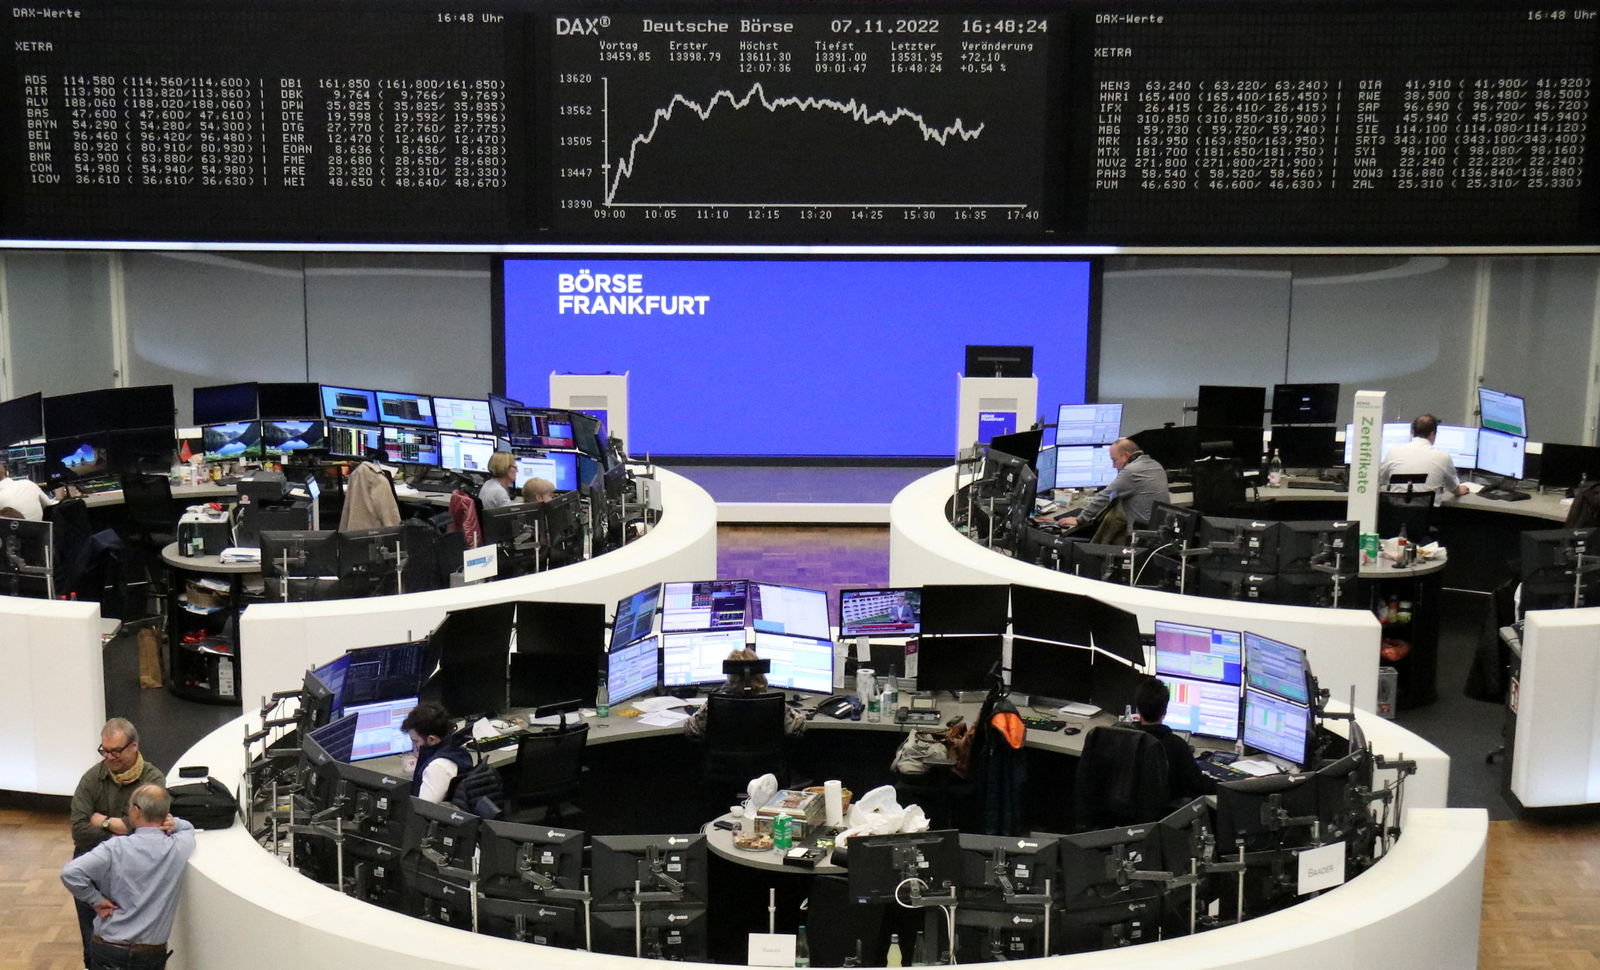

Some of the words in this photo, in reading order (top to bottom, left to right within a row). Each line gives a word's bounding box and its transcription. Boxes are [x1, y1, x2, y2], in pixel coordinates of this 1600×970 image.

[13, 8, 81, 18] DAX-Werte
[1528, 10, 1566, 20] 16:48
[1574, 10, 1597, 20] Uhr
[438, 13, 474, 22] 16:48
[482, 14, 504, 23] Uhr
[1096, 14, 1164, 24] DAX-Werte
[643, 19, 729, 32] Deutsche
[740, 19, 794, 32] Börse
[831, 20, 939, 34] 07.11.2022
[962, 20, 1048, 34] 16:48:24
[15, 42, 53, 51] XETRA
[600, 41, 638, 53] Vortag
[670, 41, 708, 50] Erster
[740, 41, 778, 50] Höchst
[815, 41, 854, 50] Tiefst
[891, 41, 936, 50] Letzter
[962, 42, 1033, 52] Veränderung
[600, 52, 651, 61] 13459.85
[670, 52, 721, 62] 13398.79
[740, 52, 791, 62] 13611.30
[816, 52, 867, 62] 13391.00
[891, 52, 943, 62] 13531.95
[961, 52, 1000, 62] +72.10
[1094, 48, 1132, 57] XETRA
[740, 64, 791, 72] 12:07:36
[815, 64, 867, 73] 09:01:47
[891, 64, 942, 73] 16:48:24
[960, 64, 993, 73] +0.54
[25, 76, 47, 84] ADS
[64, 76, 114, 85] 114,580
[560, 74, 592, 83] 13620
[280, 79, 301, 88] DB1
[320, 79, 370, 88] 161,850
[1100, 81, 1130, 90] HEN3
[1146, 81, 1191, 90] 63,240
[1359, 80, 1382, 89] QIA
[1405, 80, 1451, 89] 41,910
[26, 87, 47, 95] AIR
[65, 87, 115, 96] 113,900
[281, 90, 303, 98] DBK
[334, 90, 370, 99] 9,764
[1358, 92, 1381, 100] RWE
[1405, 91, 1450, 100] 38,500
[1100, 92, 1128, 101] HNR1
[1139, 92, 1190, 101] 165,400
[26, 98, 48, 106] ALV
[65, 98, 116, 107] 188,060
[282, 101, 303, 110] DPW
[327, 101, 370, 110] 35,825
[1358, 103, 1380, 112] SAP
[1404, 102, 1449, 111] 96,690
[560, 106, 592, 115] 13562
[1101, 103, 1122, 112] IFX
[1145, 104, 1190, 112] 26,415
[27, 109, 48, 117] BAS
[72, 109, 116, 118] 47,600
[282, 112, 303, 121] DTE
[328, 112, 371, 121] 19,598
[1357, 114, 1379, 122] SHL
[1403, 113, 1448, 122] 45,940
[1099, 115, 1121, 123] LIN
[1137, 114, 1189, 123] 310,850
[28, 120, 57, 128] BAYN
[73, 120, 117, 129] 54,290
[282, 122, 304, 132] DTG
[327, 123, 371, 132] 27,770
[1356, 125, 1378, 134] SIE
[1396, 124, 1448, 133] 114,100
[1098, 125, 1120, 134] MBG
[1144, 125, 1188, 134] 59,730
[28, 131, 49, 139] BEI
[73, 131, 117, 140] 96,460
[283, 134, 304, 142] ENR
[329, 134, 371, 143] 12,470
[1356, 136, 1385, 145] SRT3
[1394, 135, 1446, 144] 343,100
[561, 137, 592, 146] 13505
[1098, 136, 1120, 145] MRK
[1137, 137, 1188, 145] 163,950
[29, 142, 51, 150] BMW
[74, 142, 118, 151] 80,920
[283, 144, 312, 154] EOAN
[335, 145, 372, 154] 8,636
[1355, 147, 1375, 156] SY1
[1401, 146, 1446, 155] 98,100
[1098, 147, 1120, 156] MTX
[1137, 147, 1187, 156] 181,700
[29, 153, 51, 161] BNR
[75, 153, 119, 162] 63,900
[283, 155, 305, 164] FME
[328, 156, 372, 165] 28,680
[1354, 158, 1376, 167] VNA
[1400, 157, 1445, 166] 22,240
[1097, 158, 1126, 167] MUV2
[1135, 158, 1187, 167] 271,800
[30, 164, 52, 172] CON
[75, 164, 119, 173] 54,980
[284, 166, 305, 175] FRE
[329, 167, 372, 176] 23,320
[561, 168, 592, 177] 13447
[1097, 169, 1126, 178] PAH3
[1142, 169, 1186, 178] 58,540
[1354, 169, 1383, 178] VOW3
[1392, 169, 1444, 177] 136,880
[32, 175, 60, 183] 1COV
[76, 175, 120, 184] 36,610
[284, 177, 304, 186] HEI
[329, 178, 373, 186] 48,650
[1352, 180, 1374, 189] ZAL
[1398, 179, 1443, 188] 25,310
[1096, 180, 1118, 189] PUM
[1141, 180, 1186, 189] 46,630
[561, 200, 592, 208] 13390
[594, 210, 626, 218] 09:00
[645, 210, 676, 218] 10:05
[698, 208, 729, 219] 11:10
[748, 208, 780, 219] 12:15
[801, 208, 832, 219] 13:20
[852, 210, 883, 219] 14:25
[904, 210, 936, 220] 15:30
[955, 210, 987, 220] 16:35
[1008, 211, 1039, 220] 17:40
[559, 269, 642, 293] BÖRSE
[559, 296, 710, 314] FRANKFURT
[1357, 417, 1373, 494] Zertifikate
